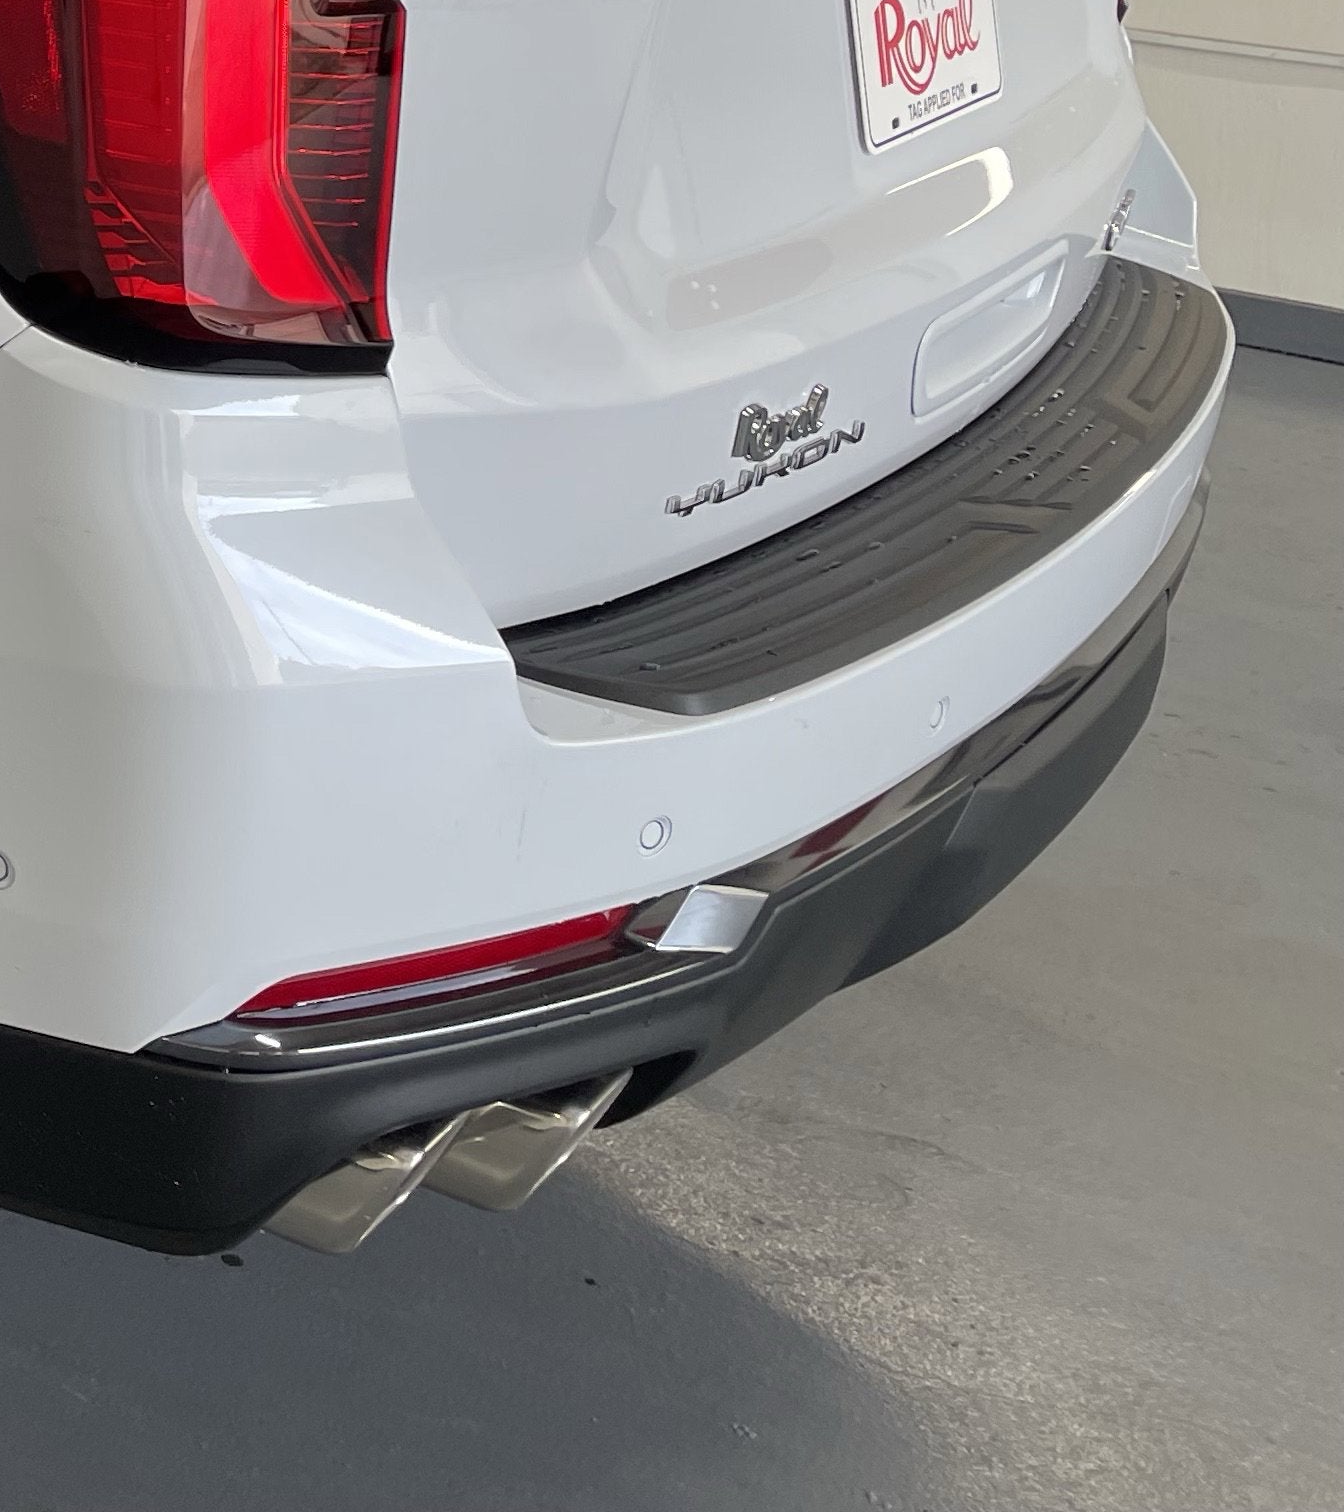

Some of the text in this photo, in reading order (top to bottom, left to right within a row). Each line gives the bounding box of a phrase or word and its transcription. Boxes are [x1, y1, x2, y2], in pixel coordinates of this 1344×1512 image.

[908, 81, 966, 121] TAG APPLIED FOR
[731, 383, 829, 461] Royal
[665, 419, 866, 517] YUKON
